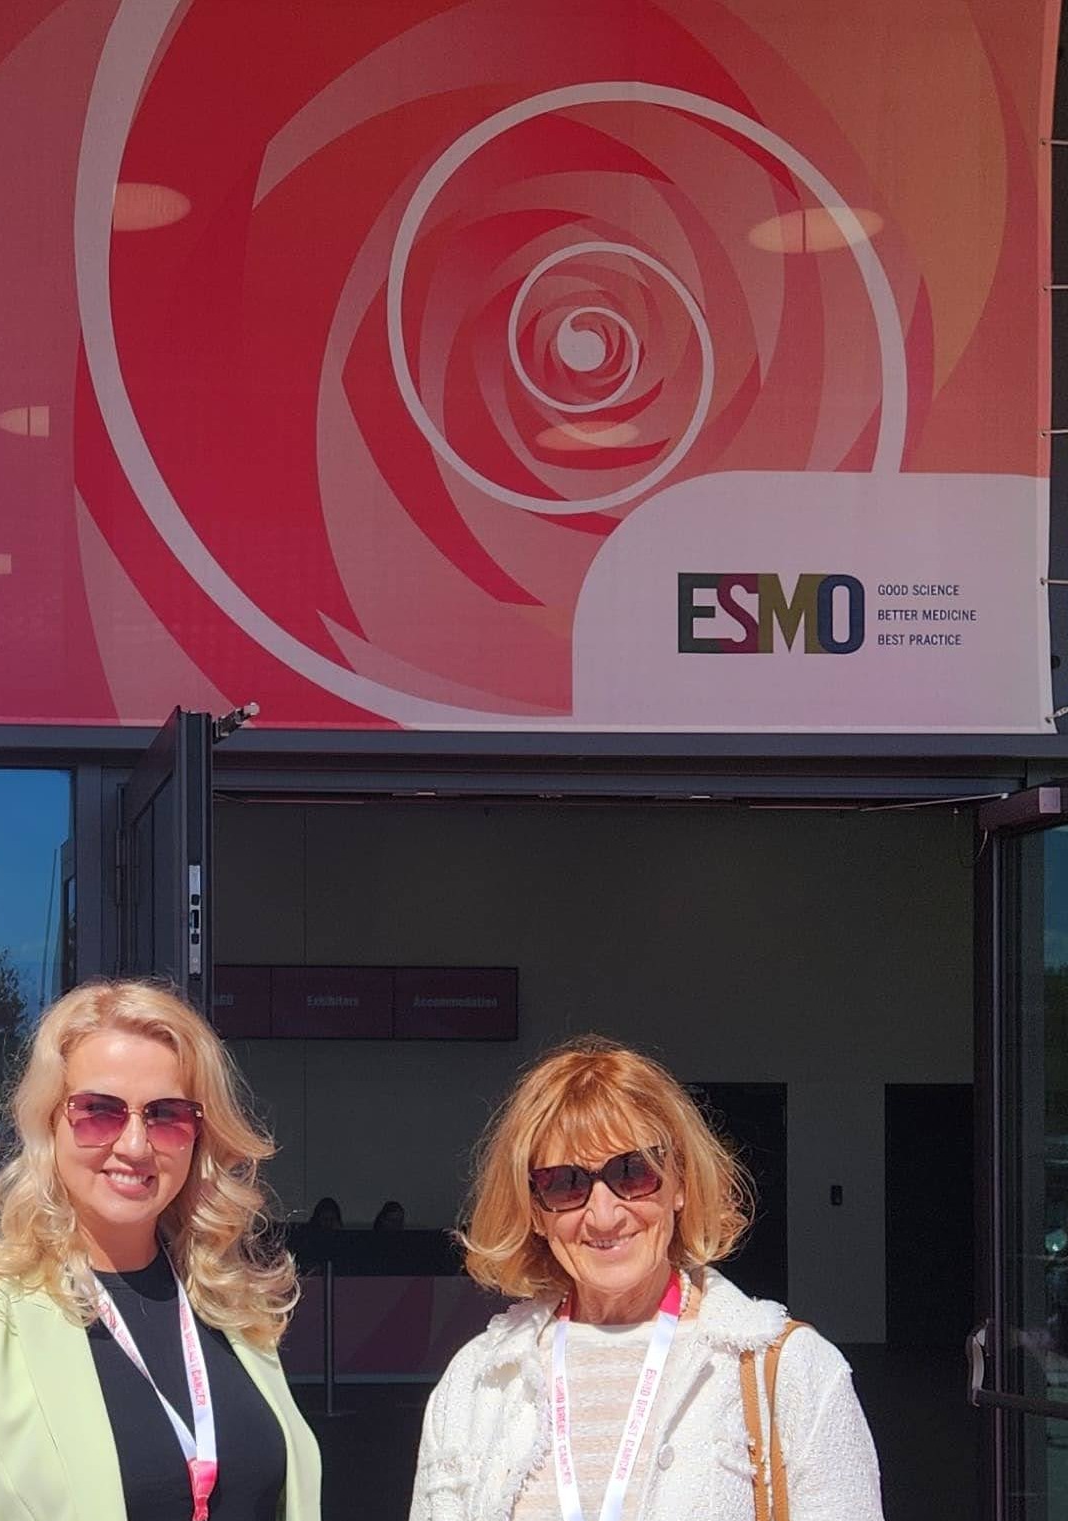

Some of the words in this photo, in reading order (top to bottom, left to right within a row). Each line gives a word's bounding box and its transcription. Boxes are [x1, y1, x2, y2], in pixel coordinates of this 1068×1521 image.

[878, 584, 909, 596] GOOD
[912, 584, 959, 596] SCIENCE
[678, 572, 865, 654] ESMO
[878, 609, 918, 621] BETTER
[921, 609, 977, 621] MEDICINE
[878, 634, 907, 646] BEST
[909, 634, 962, 646] PRACTICE
